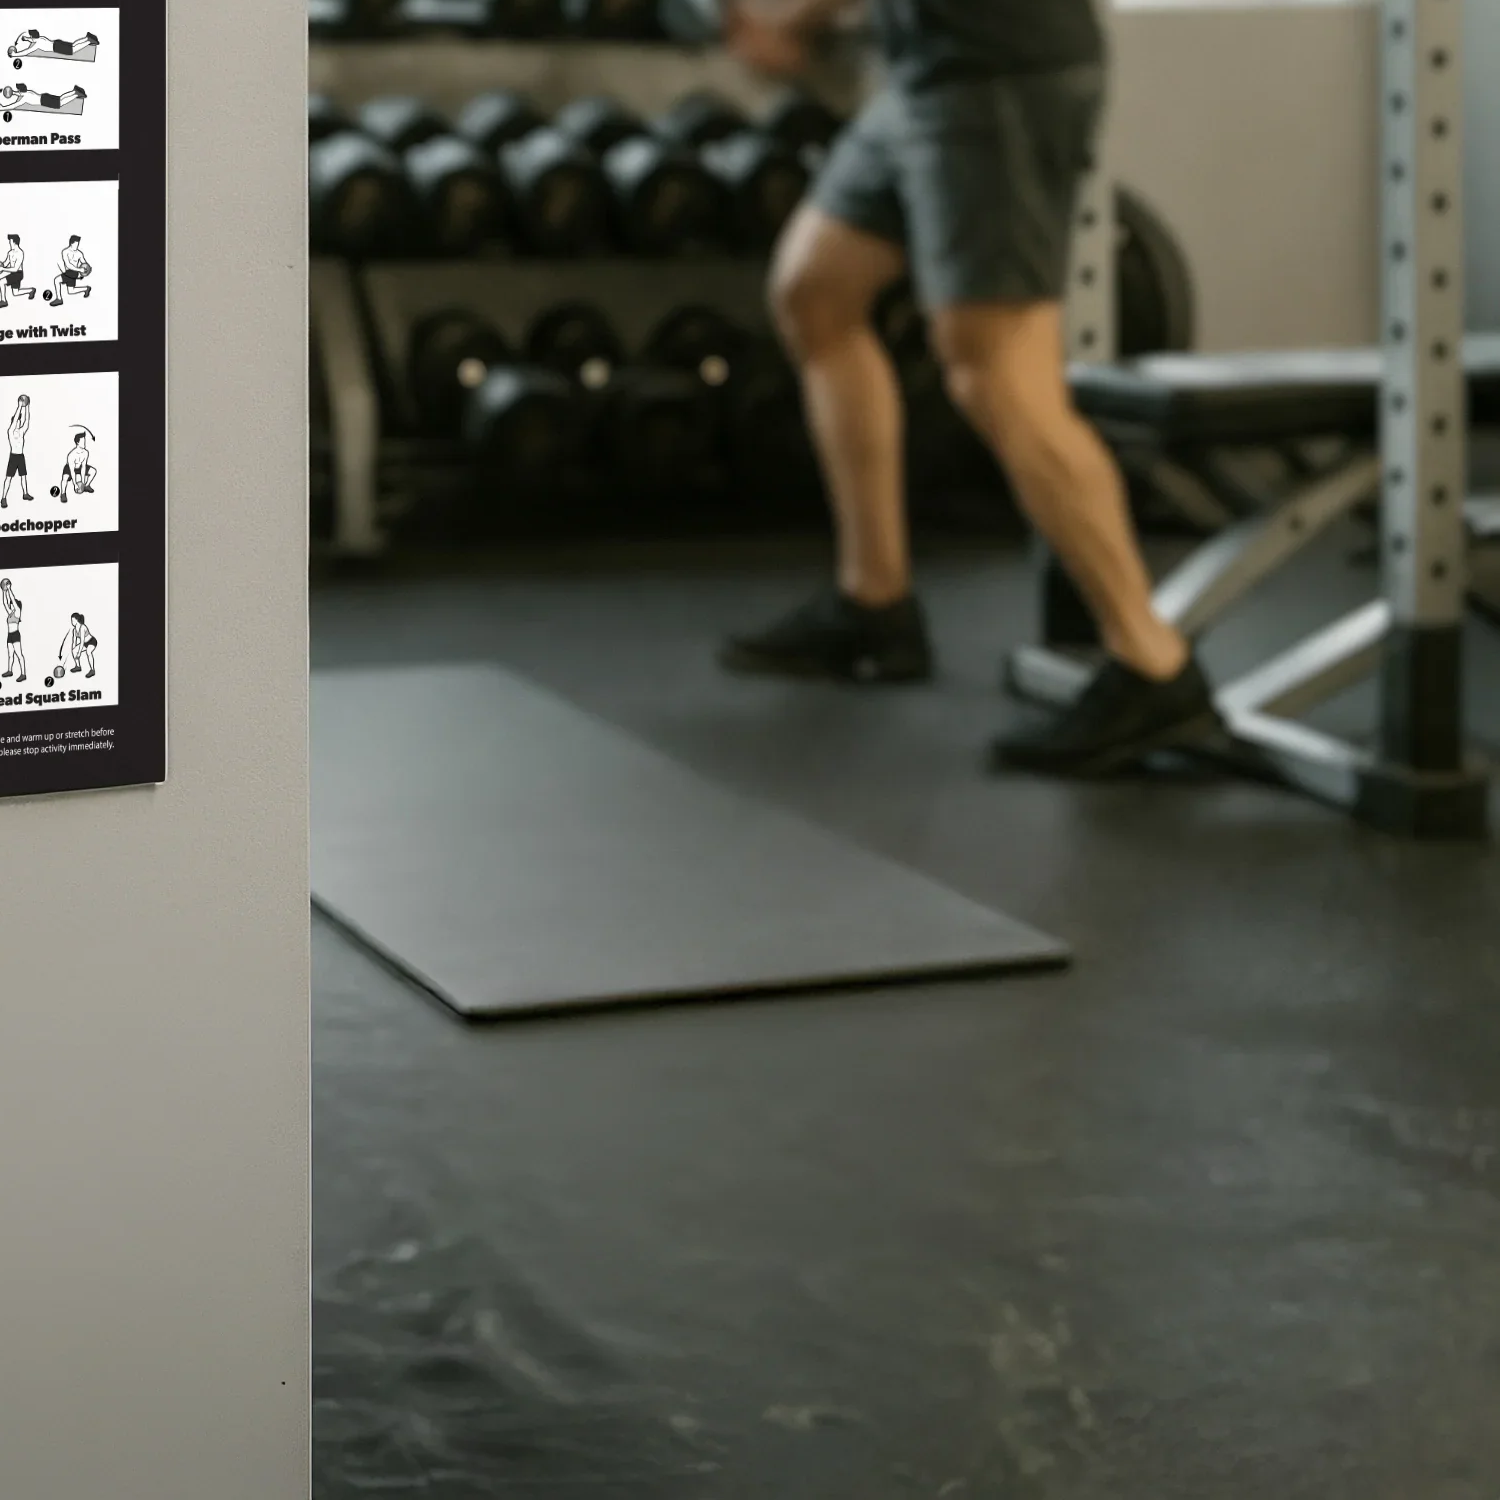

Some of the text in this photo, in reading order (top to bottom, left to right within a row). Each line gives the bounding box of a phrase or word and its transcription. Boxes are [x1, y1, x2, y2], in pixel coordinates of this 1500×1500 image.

[51, 133, 81, 144] Pass
[16, 325, 47, 338] with
[50, 324, 86, 337] Twist
[25, 691, 66, 706] Squat
[68, 689, 102, 701] Slam
[6, 733, 21, 743] and
[22, 734, 43, 742] warm
[44, 733, 54, 742] up
[65, 729, 90, 739] stretch
[91, 727, 115, 737] before
[23, 746, 39, 755] stop
[40, 744, 67, 754] activity
[68, 739, 115, 751] immediately.
